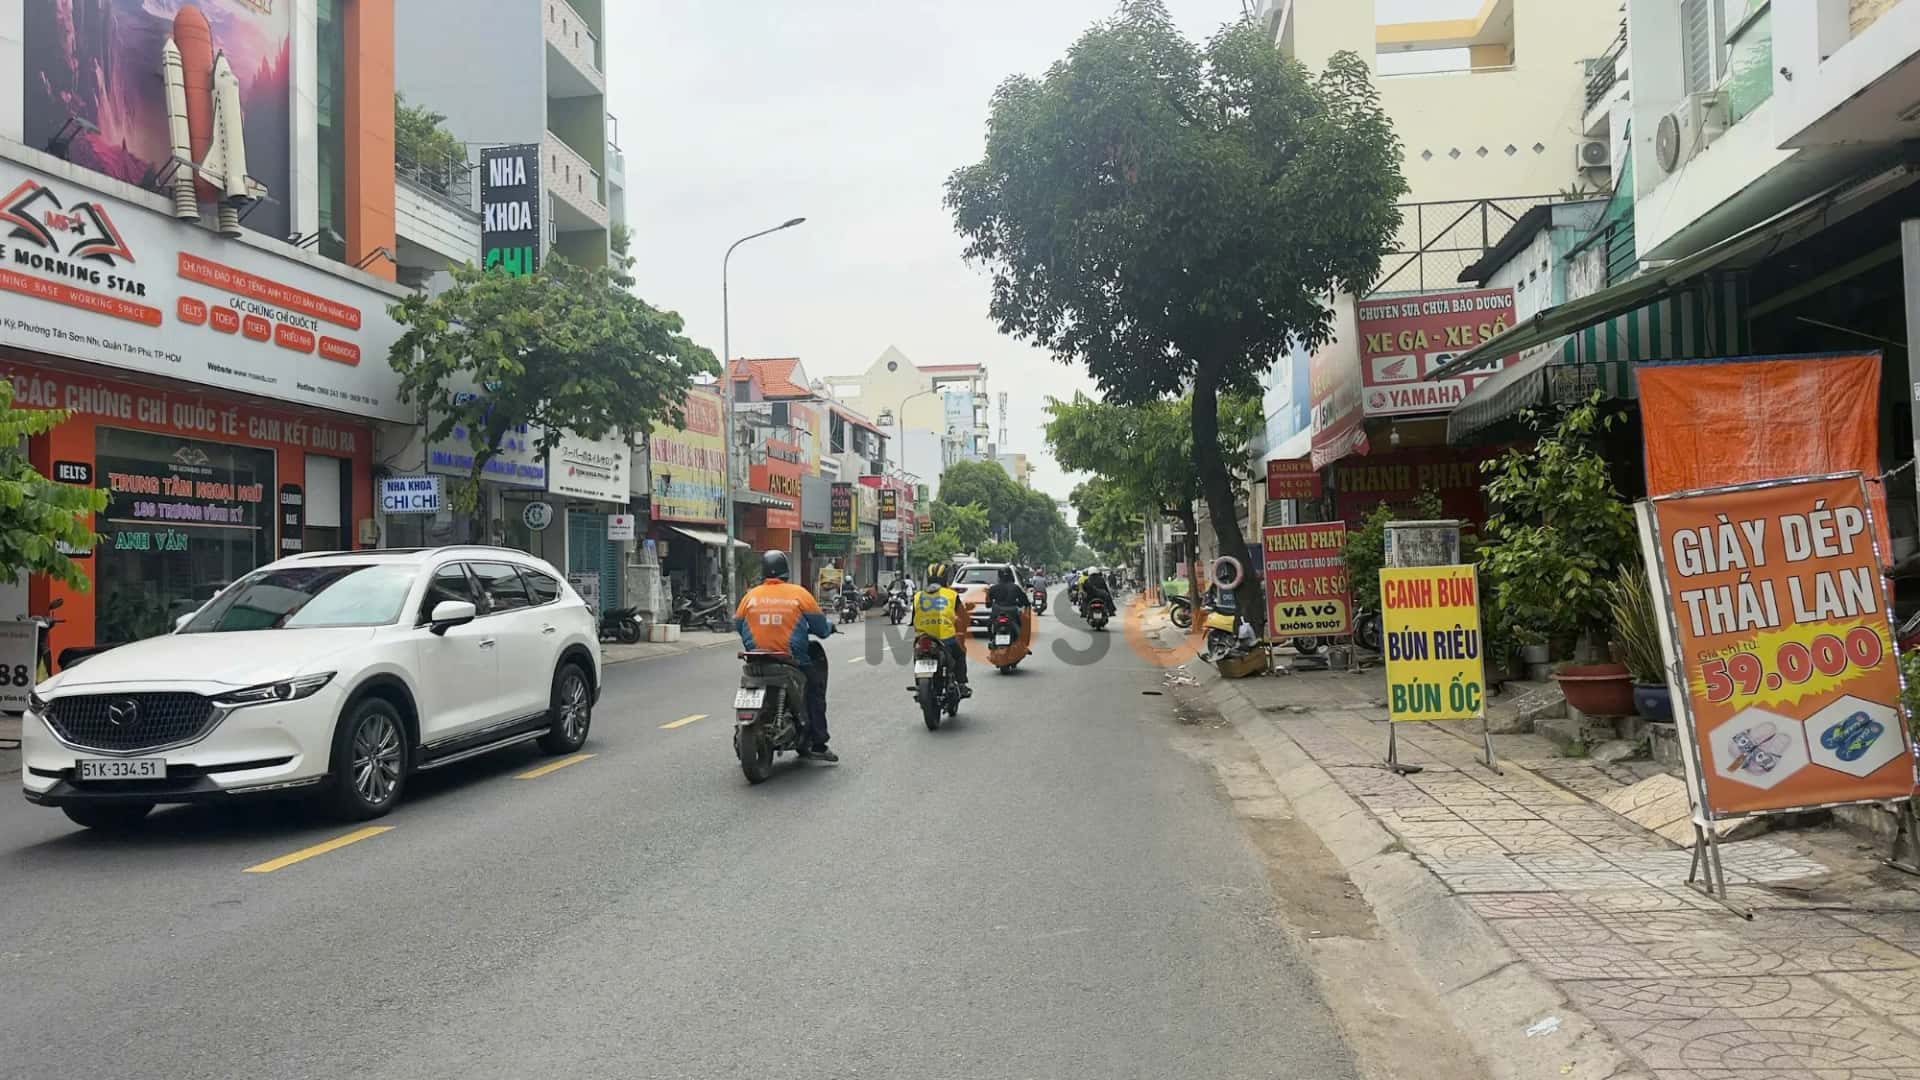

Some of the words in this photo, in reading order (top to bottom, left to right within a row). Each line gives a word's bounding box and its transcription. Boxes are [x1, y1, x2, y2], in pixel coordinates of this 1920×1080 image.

[489, 156, 526, 187] NHA
[485, 201, 532, 232] KHOA
[14, 248, 100, 285] MORNING
[107, 275, 146, 297] STAR
[33, 283, 58, 297] BASE
[70, 292, 112, 309] WORKING
[118, 303, 145, 319] SPACE
[182, 302, 203, 318] IELTS
[229, 297, 246, 312] CÁC
[247, 301, 275, 320] CHỨNG
[214, 312, 236, 327] TOEIC
[247, 320, 268, 335] TOEFL
[1365, 332, 1394, 353] XE
[1398, 329, 1429, 351] GA
[1444, 325, 1472, 347] XE
[1388, 385, 1461, 407] YAMAHA
[14, 373, 57, 408] CÁC
[65, 383, 132, 419] CHỨNG
[137, 392, 167, 425] CHỈ
[173, 401, 216, 431] QUỐC
[220, 406, 238, 435] TẾ
[249, 416, 280, 441] CAM
[283, 419, 308, 445] KẾT
[339, 431, 356, 453] RA
[60, 464, 87, 480] IELTS
[108, 472, 160, 495] TRUNG
[162, 475, 193, 498] TÂM
[196, 480, 235, 504] NGOẠI
[387, 481, 405, 491] NHA
[408, 480, 432, 491] KHOA
[383, 495, 409, 509] CHI
[411, 494, 437, 508] CHI
[115, 531, 150, 550] ANH
[154, 529, 189, 550] VĂN
[1671, 512, 1767, 578] GIÀY
[1779, 499, 1865, 564] DÉP
[1272, 578, 1288, 597] XE
[1289, 577, 1306, 597] GA
[1313, 576, 1329, 595] XE
[1384, 578, 1433, 609] CANH
[1437, 571, 1474, 607] BÚN
[1311, 602, 1337, 617] VỎ
[1680, 572, 1781, 637] THÁI
[1786, 565, 1878, 624] LAN
[1280, 621, 1314, 631] KHÔNG
[1388, 625, 1428, 661] BÚN
[1433, 624, 1478, 660] RIÊU
[1701, 625, 1883, 702] 59.000
[1391, 677, 1441, 713] BÚN
[1449, 672, 1481, 712] ỐC
[83, 762, 157, 777] 51K-334.51
